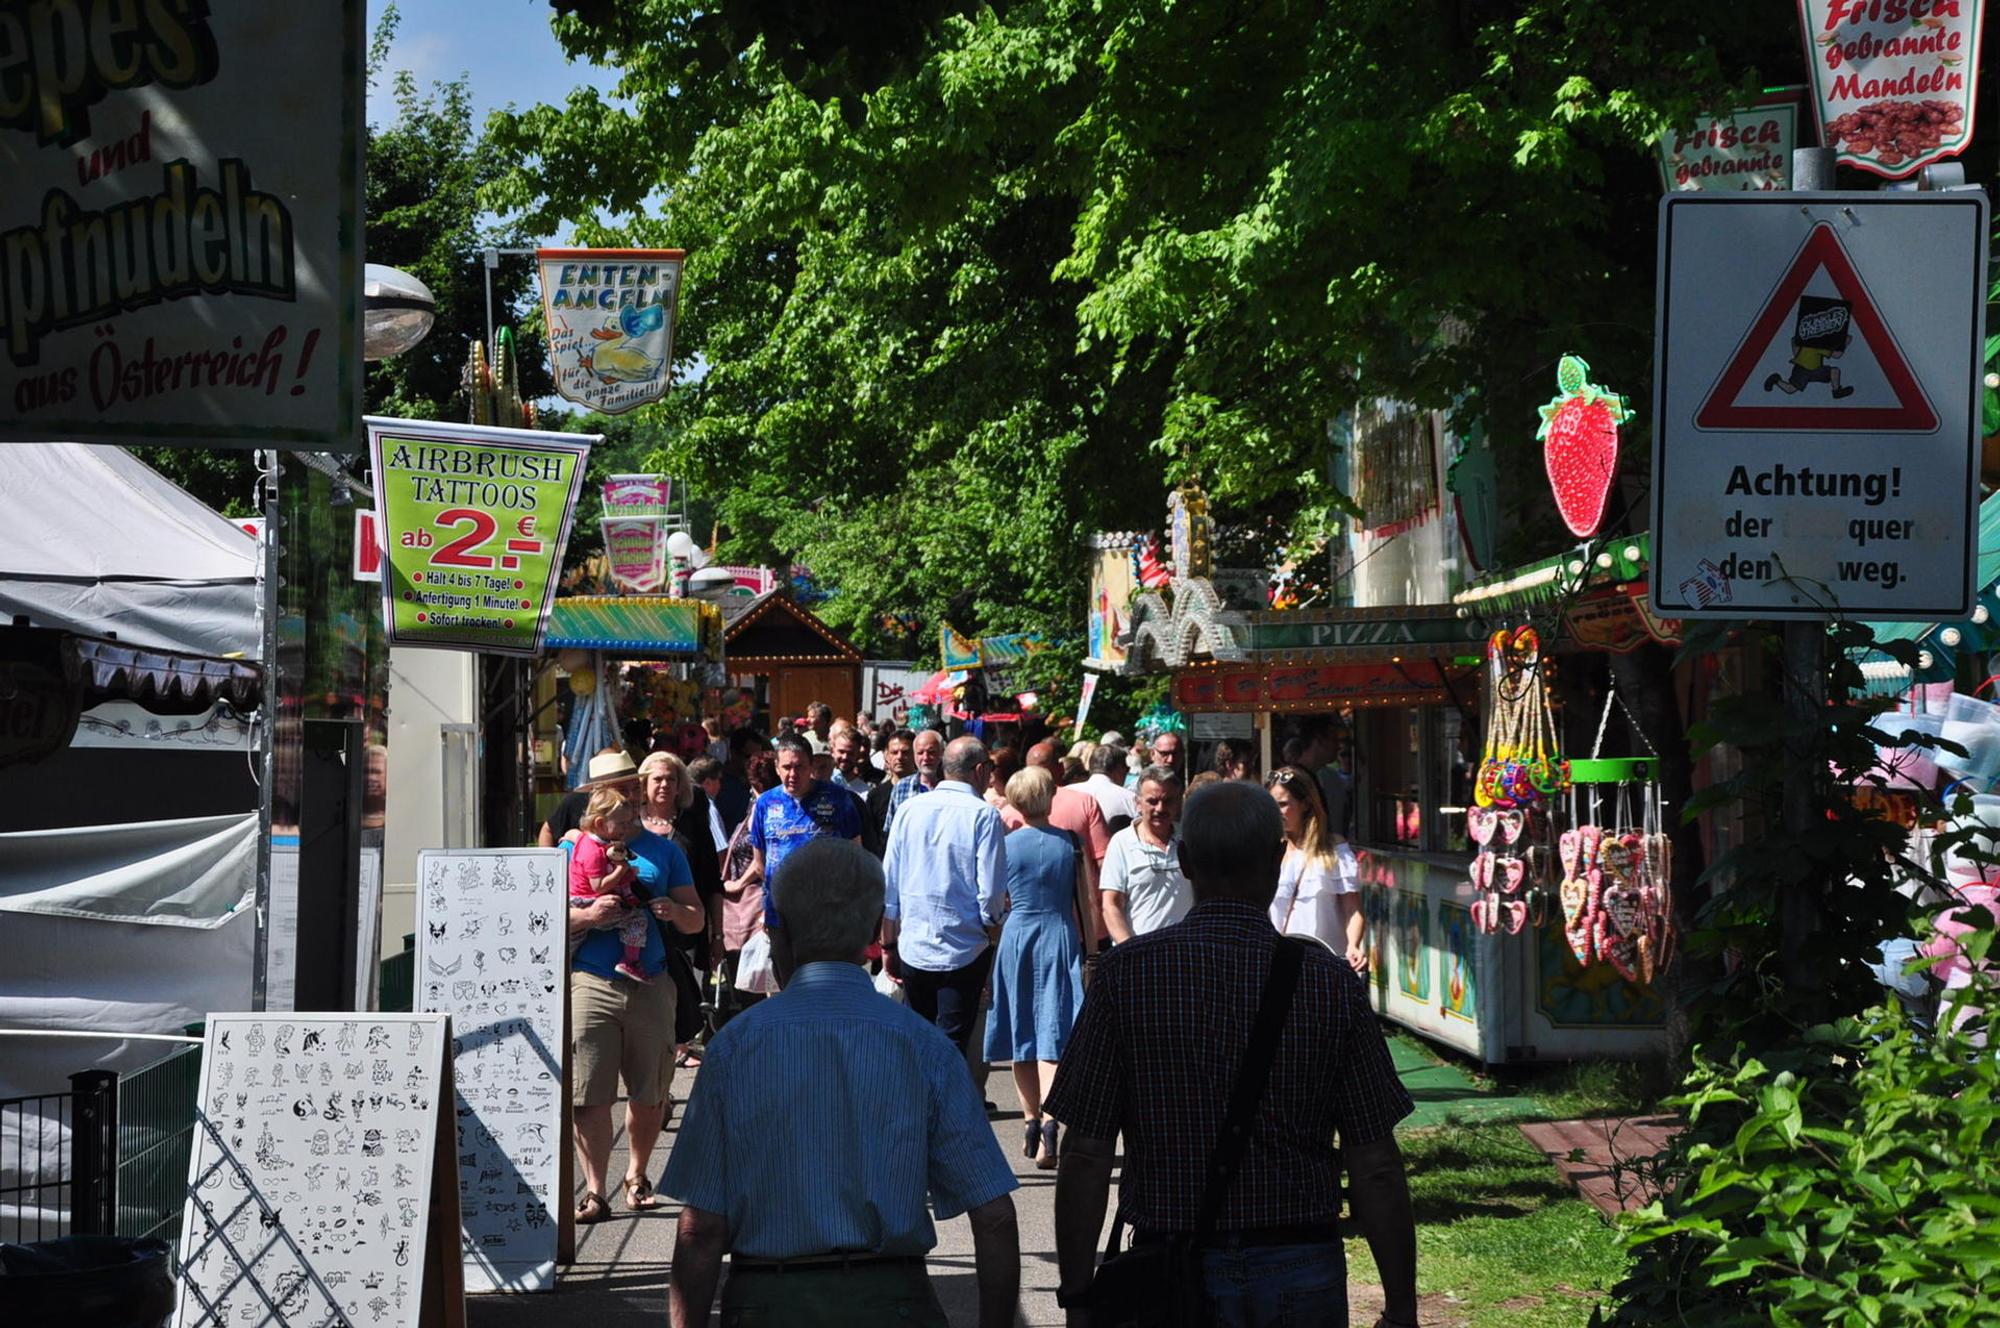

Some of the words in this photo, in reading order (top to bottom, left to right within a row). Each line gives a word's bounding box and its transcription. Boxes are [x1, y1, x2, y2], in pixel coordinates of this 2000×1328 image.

[1824, 0, 1962, 30] Frisch
[1825, 26, 1962, 69] gebrannte
[1827, 63, 1963, 101] Mandeln
[78, 110, 151, 186] und
[1675, 154, 1783, 185] gebrannte
[560, 264, 671, 287] ENTEN-
[552, 288, 672, 311] ANGELN
[551, 328, 574, 340] Das
[561, 368, 581, 381] für
[572, 380, 591, 390] die
[15, 365, 79, 413] aus
[585, 384, 621, 400] ganze
[389, 445, 562, 482] AIRBRUSH
[411, 476, 537, 510] TATTOOS
[1725, 464, 1901, 506] Achtung!
[401, 528, 433, 548] ab
[1725, 510, 1773, 538] der
[1848, 517, 1914, 550] quer
[448, 573, 456, 584] 4
[458, 574, 472, 587] bis
[475, 575, 481, 587] 7
[484, 575, 511, 592] Tage!
[1719, 552, 1772, 580] den
[1838, 560, 1907, 590] weg.
[415, 591, 472, 609] Anfertigung
[475, 595, 480, 607] 1
[483, 595, 519, 610] Minute!
[430, 612, 459, 626] Sofort
[462, 615, 502, 630] trocken!
[1311, 621, 1416, 646] PIZZA
